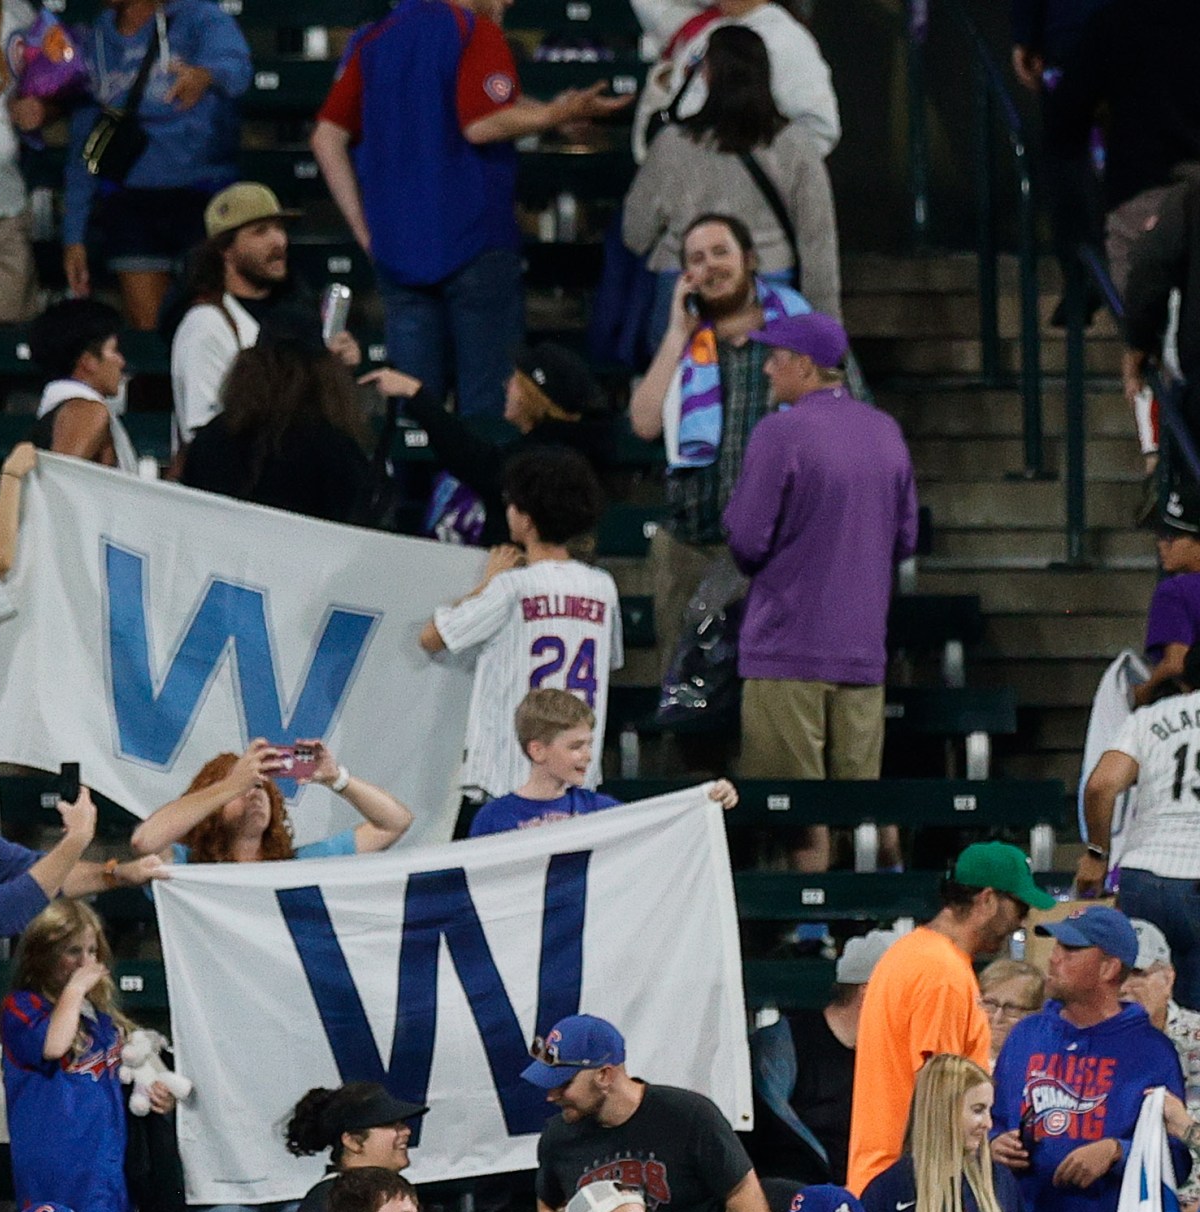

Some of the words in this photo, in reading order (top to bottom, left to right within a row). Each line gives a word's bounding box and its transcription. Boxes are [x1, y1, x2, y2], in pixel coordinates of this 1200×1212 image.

[99, 535, 383, 803] W
[529, 635, 598, 710] 24
[276, 850, 593, 1148] W
